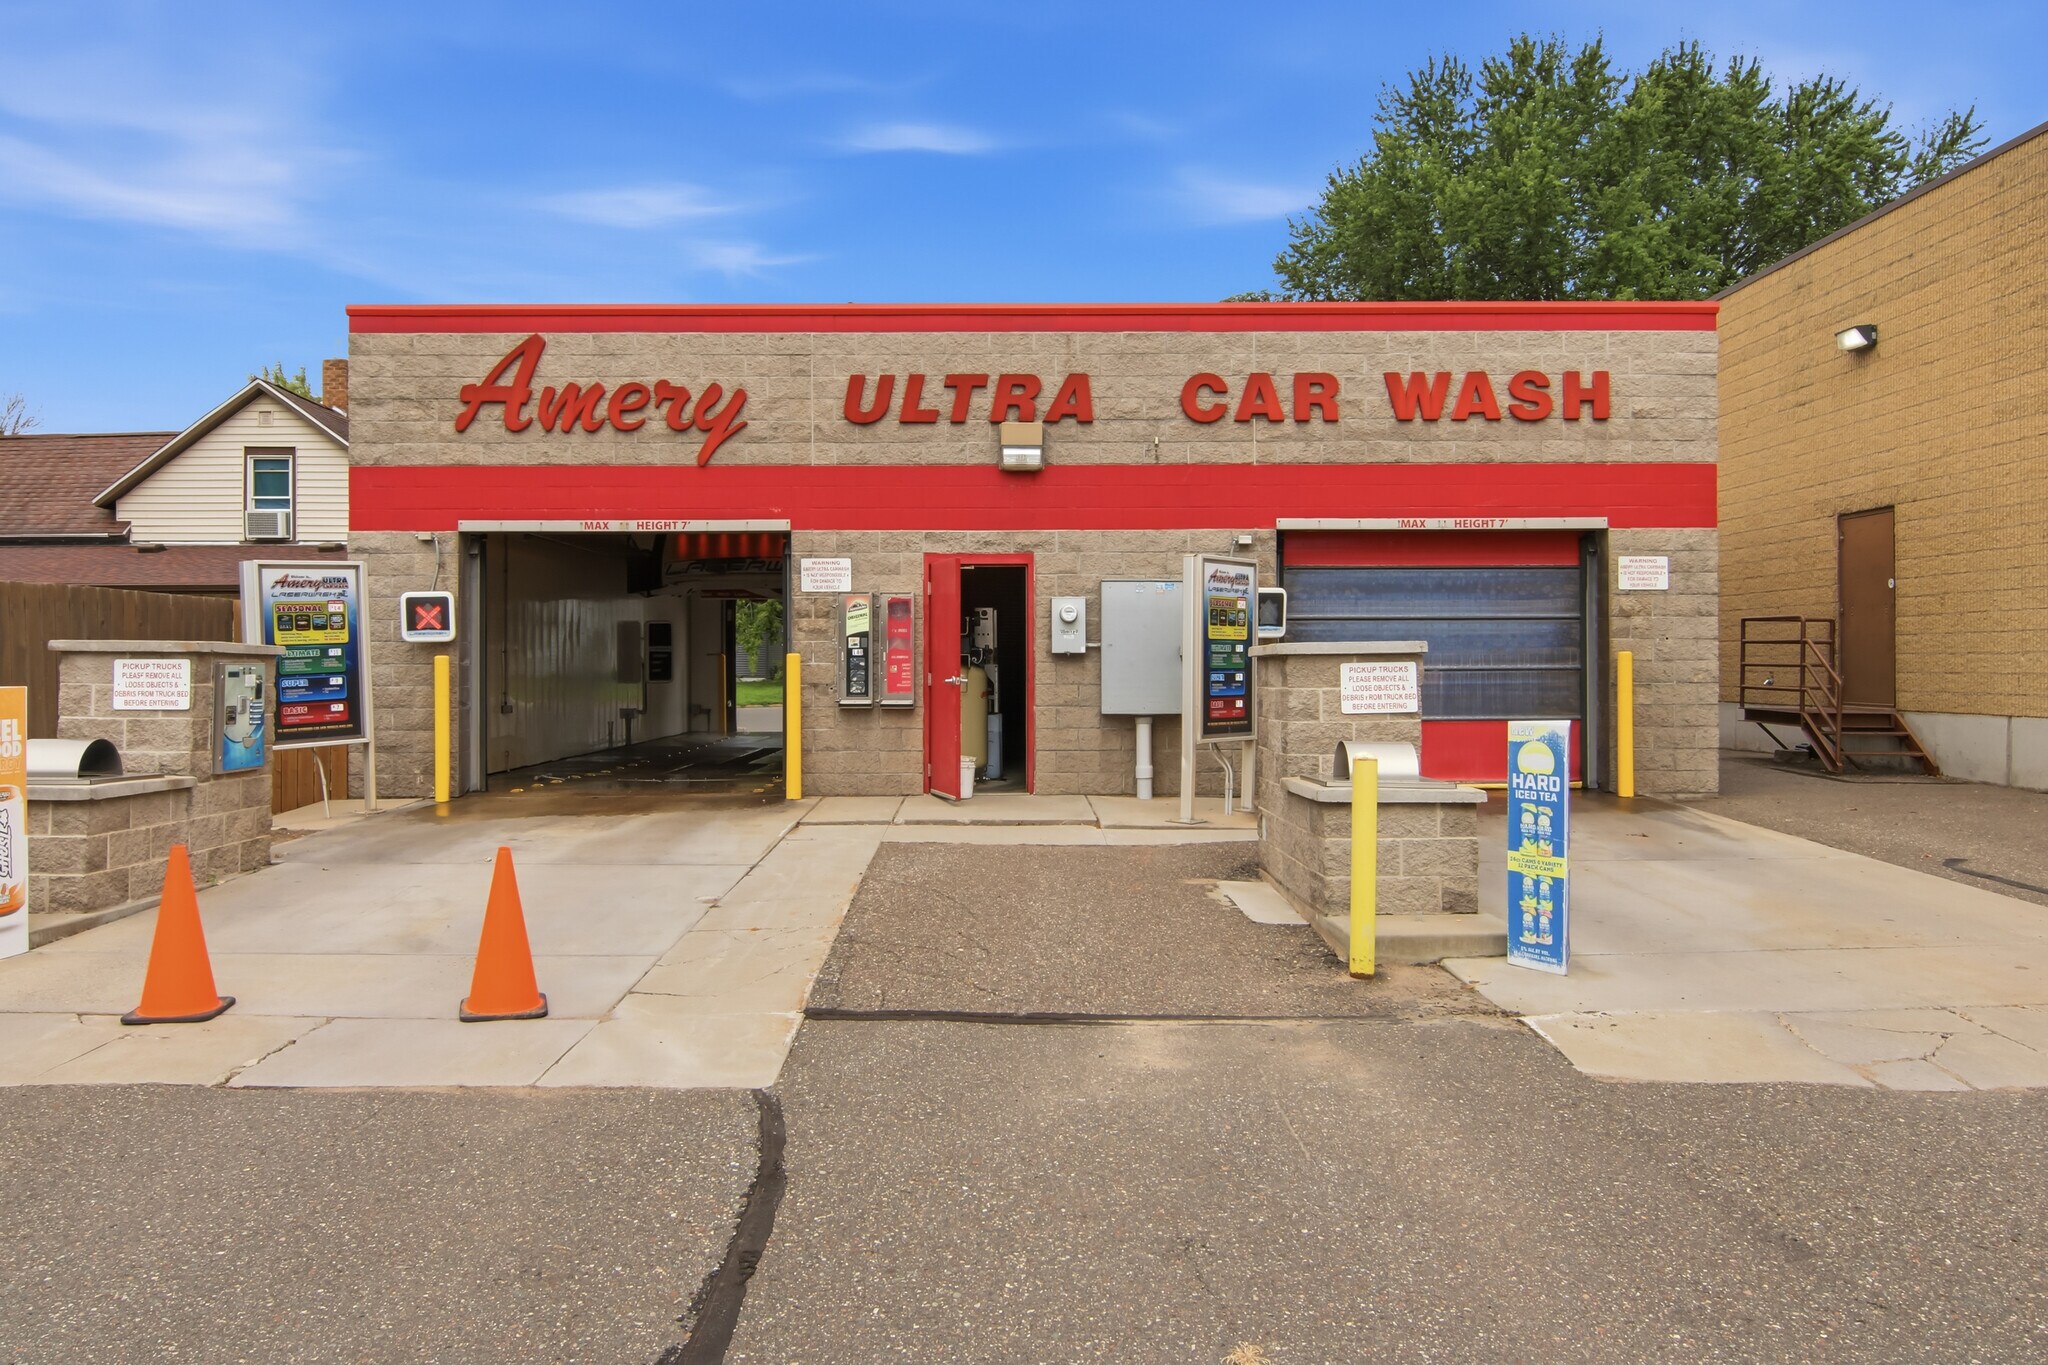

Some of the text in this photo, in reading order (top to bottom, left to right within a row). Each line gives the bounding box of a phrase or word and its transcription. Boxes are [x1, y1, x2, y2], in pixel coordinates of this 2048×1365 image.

[455, 333, 748, 468] Amery
[843, 371, 1611, 424] ULTRA CAR WASH
[584, 521, 609, 530] MAX
[637, 521, 678, 530] HEIGHT
[1401, 519, 1426, 528] MAX
[1454, 519, 1496, 528] HEIGHT
[271, 573, 347, 592] Amery ULTRA
[282, 649, 320, 657] LTIMATE
[283, 706, 308, 714] BASIC
[0, 719, 21, 740] EL
[0, 741, 21, 757] OD
[1512, 773, 1560, 792] HARD
[1515, 789, 1558, 802] ICED TEA
